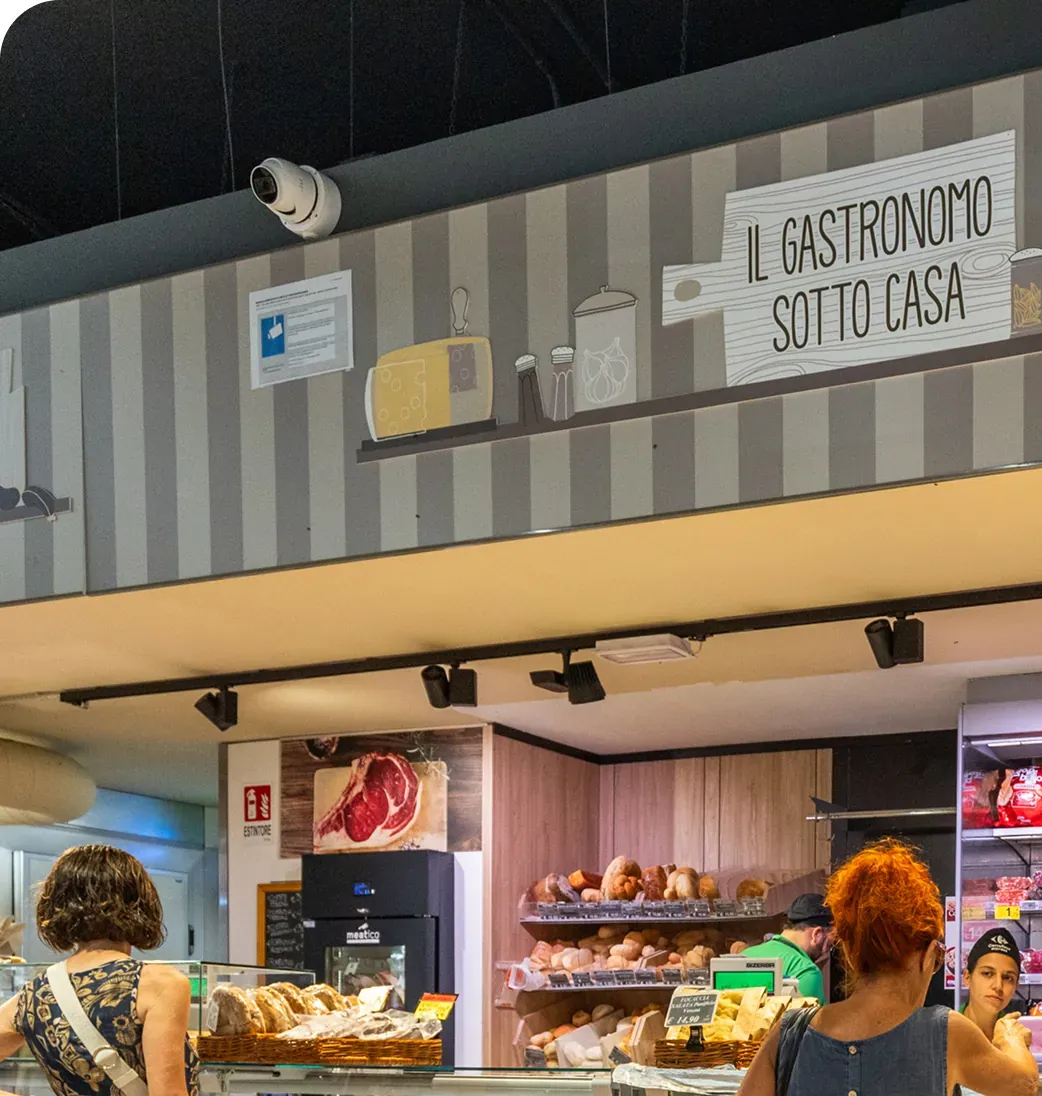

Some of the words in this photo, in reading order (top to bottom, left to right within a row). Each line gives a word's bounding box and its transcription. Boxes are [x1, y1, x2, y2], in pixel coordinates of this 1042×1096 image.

[746, 223, 769, 284] IL
[782, 175, 993, 276] GASTRONOMO
[772, 279, 871, 353] SOTTO
[885, 261, 966, 333] CASA
[243, 824, 272, 838] ESTINTORE
[346, 930, 380, 940] meatico
